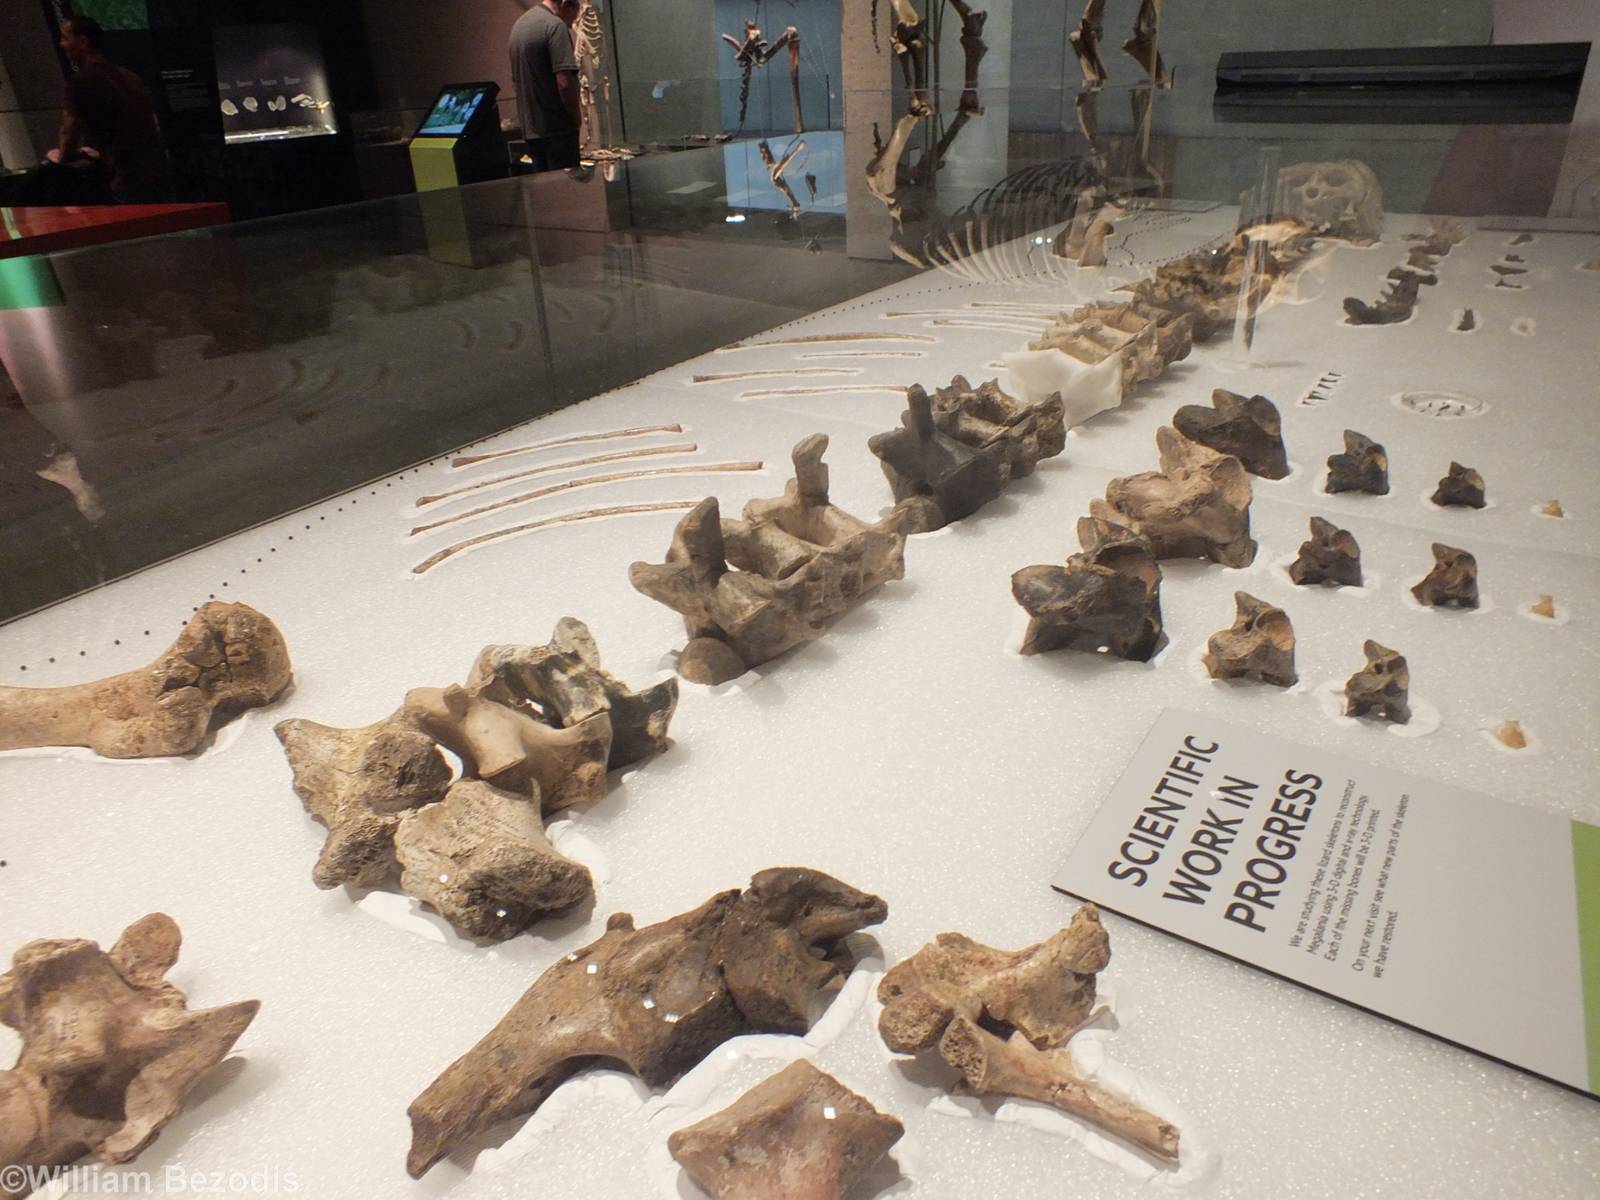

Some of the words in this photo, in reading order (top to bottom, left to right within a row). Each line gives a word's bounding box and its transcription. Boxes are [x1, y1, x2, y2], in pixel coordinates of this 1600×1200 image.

[1108, 735, 1219, 887] SCIENTIFIC
[1334, 811, 1345, 819] to
[1389, 829, 1400, 838] of
[1392, 819, 1403, 830] the
[1162, 807, 1243, 907] WORK
[1219, 775, 1259, 809] IN
[1357, 845, 1370, 854] be
[1386, 838, 1399, 857] parts
[1224, 769, 1322, 933] PROGRESS
[1355, 853, 1366, 866] will
[1382, 856, 1393, 871] new
[1310, 868, 1326, 888] these
[1346, 866, 1363, 889] bones
[1376, 870, 1389, 889] what
[1301, 888, 1322, 921] studying
[1306, 915, 1329, 955] Megalania
[1322, 894, 1338, 915] using
[1332, 857, 1347, 880] digital
[1341, 843, 1352, 858] and
[1339, 888, 1359, 917] missing
[1373, 889, 1385, 903] see
[1368, 902, 1381, 919] visit
[1296, 921, 1308, 934] are
[1334, 917, 1348, 931] the
[1363, 919, 1376, 938] next
[1288, 934, 1303, 948] We
[1331, 929, 1343, 941] of
[1323, 941, 1340, 962] Each
[1358, 938, 1371, 959] your
[1373, 944, 1390, 966] have
[1351, 958, 1365, 972] On
[1373, 965, 1384, 978] we
